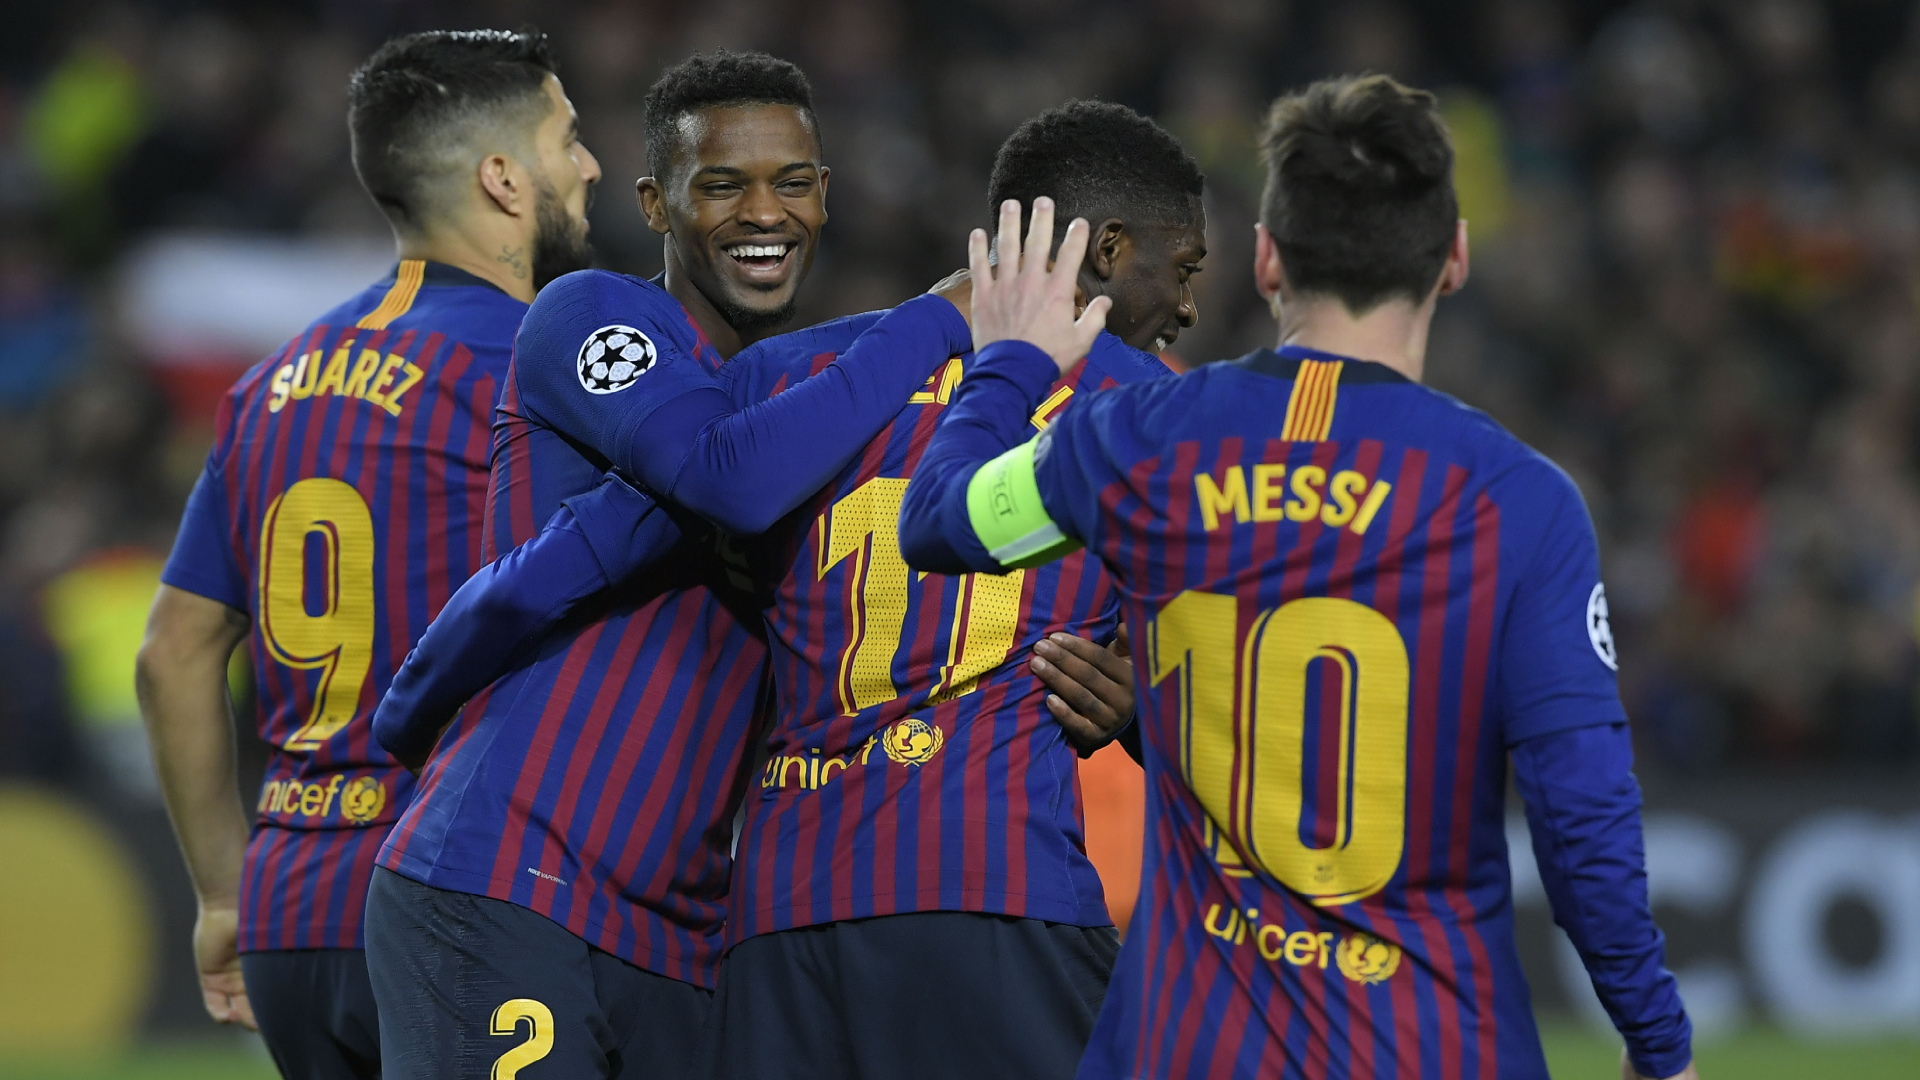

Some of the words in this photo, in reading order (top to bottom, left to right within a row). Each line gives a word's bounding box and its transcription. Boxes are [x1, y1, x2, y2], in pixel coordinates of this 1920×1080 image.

[269, 339, 424, 417] SUÁREZ
[1194, 463, 1392, 535] MESSI
[259, 477, 375, 751] 9
[817, 476, 1025, 716] 11
[1147, 589, 1410, 907] 10
[257, 774, 345, 818] nicef
[490, 998, 554, 1080] 2
